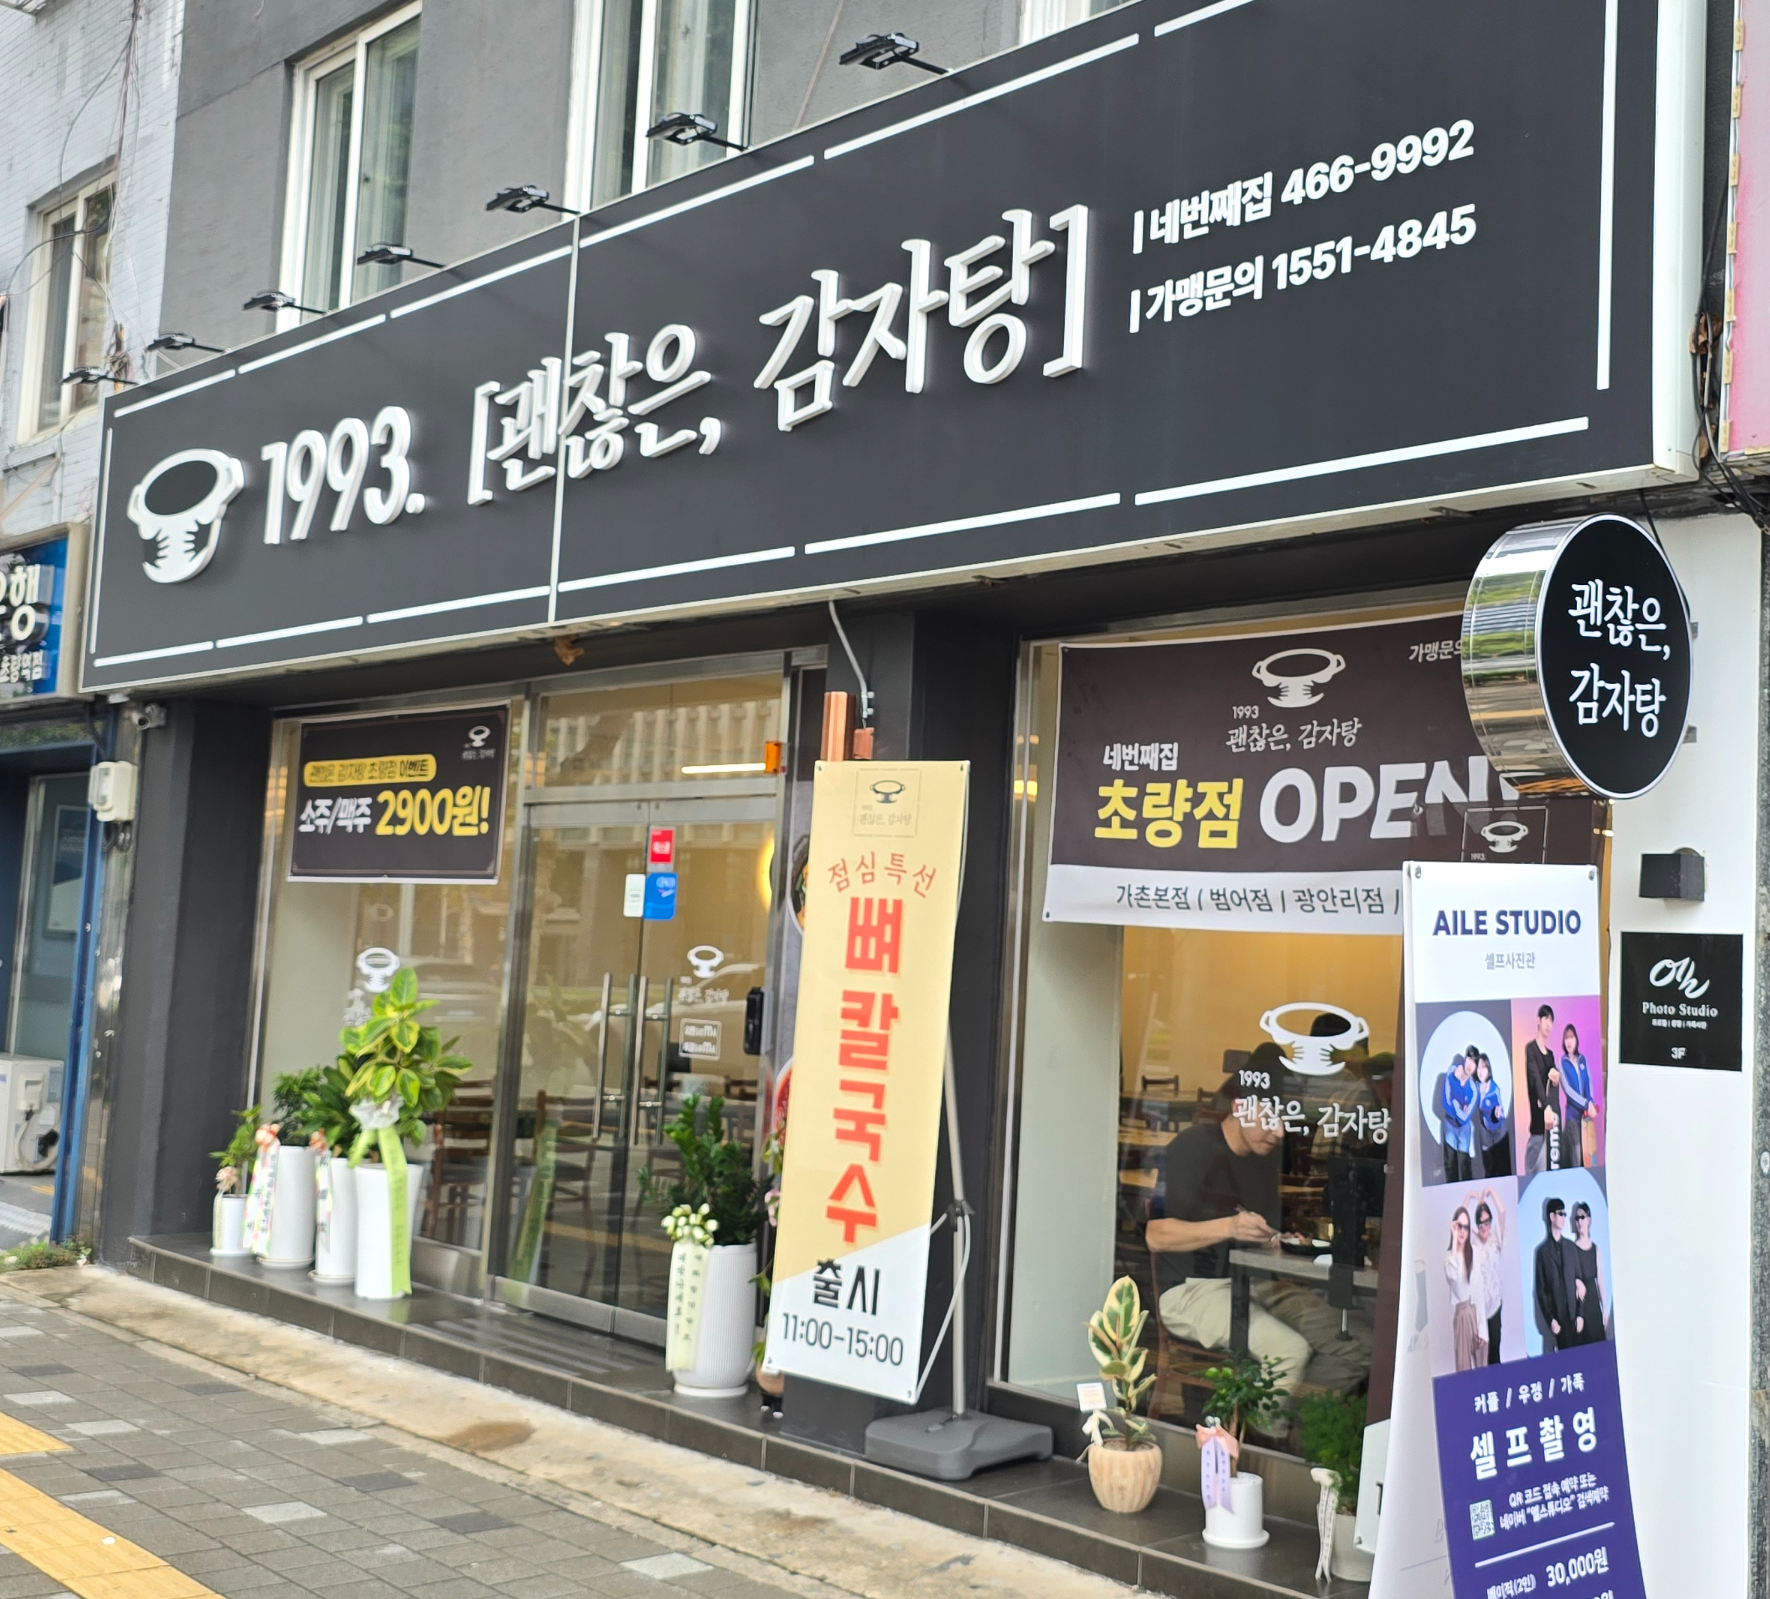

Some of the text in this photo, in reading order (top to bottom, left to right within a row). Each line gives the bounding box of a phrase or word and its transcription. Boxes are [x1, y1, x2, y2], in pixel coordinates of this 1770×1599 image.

[1150, 119, 1474, 244] 네번째집 466-9992
[1146, 203, 1477, 322] 가맹문의 1551-4845
[261, 406, 425, 544] 1993.
[1568, 579, 1671, 660] 괜찮은,
[1232, 705, 1260, 719] 1993
[1568, 662, 1667, 738] 감자탕
[1225, 717, 1363, 753] 괜찮은, 감자탕
[399, 758, 429, 778] 이벤트
[1102, 742, 1178, 771] 네번째집
[298, 785, 491, 836] 소주/맥주 2900원!
[1094, 778, 1244, 849] 초량점
[827, 851, 937, 899] 점심특선
[1116, 883, 1385, 915] 가촌본점 범어점 광안리점
[1432, 909, 1581, 937] AILE STUDIO
[1484, 952, 1536, 970] 셀프사진관
[1642, 1001, 1719, 1018] Photo Studio
[1670, 1047, 1687, 1060] 3F
[1238, 1069, 1271, 1090] 1993
[1232, 1094, 1392, 1145] 괜찮은, 감자탕
[811, 1257, 881, 1317] 출시
[781, 1311, 904, 1367] 11:00-15:00
[1473, 1390, 1500, 1414] 커플
[1518, 1381, 1543, 1405] 우정
[1560, 1372, 1586, 1395] 가족
[1509, 1491, 1523, 1508] QR
[1546, 1546, 1610, 1587] 30,000원
